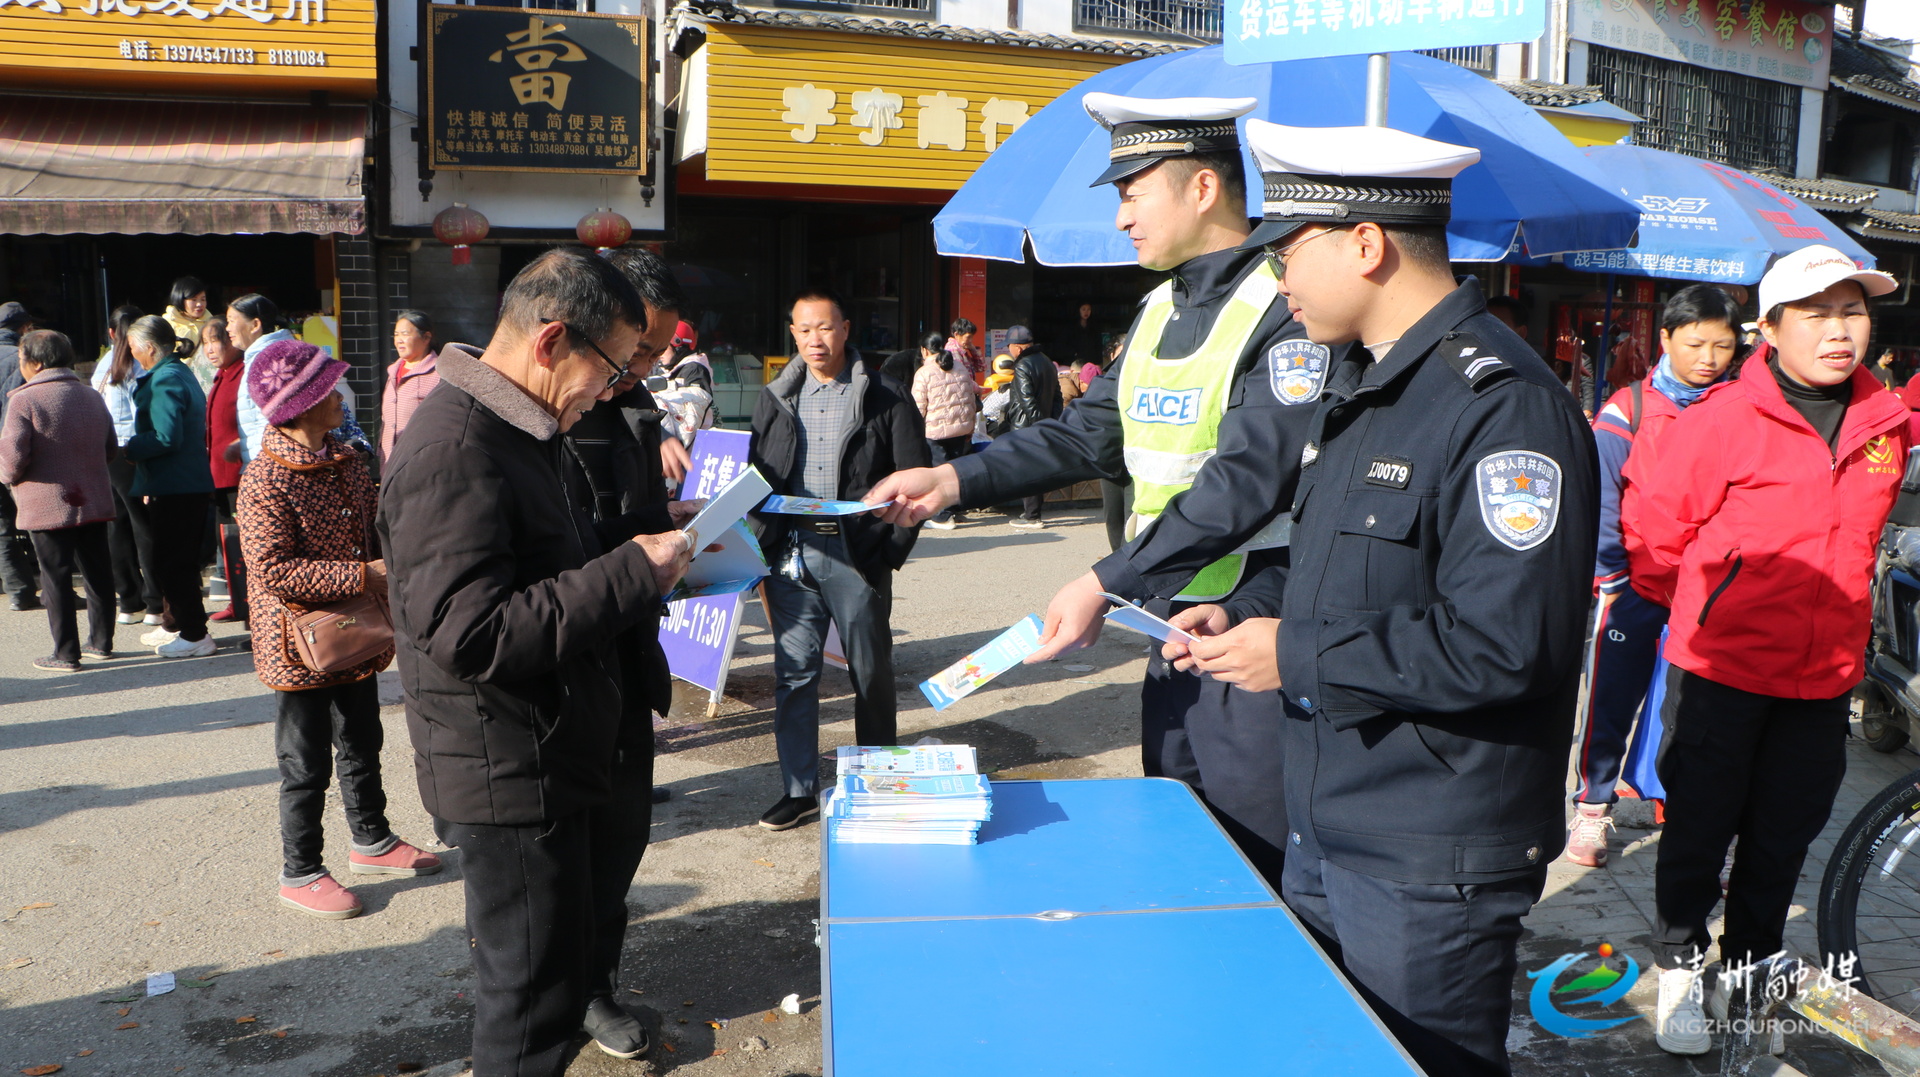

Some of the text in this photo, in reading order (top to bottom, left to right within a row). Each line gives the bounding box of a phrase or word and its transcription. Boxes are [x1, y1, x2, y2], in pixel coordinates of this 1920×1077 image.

[119, 39, 326, 66] 电话: 13974547133 8181084
[446, 109, 627, 133] 快捷诚信 简便灵活
[446, 127, 629, 145] 房产 汽车 摩托车 电动车 黄金 家电 电脑
[296, 221, 312, 232] 155
[315, 221, 335, 232] 2610
[1668, 215, 1717, 225] HORSE
[1574, 251, 1745, 278] 战马能量型维生素饮料
[1484, 456, 1556, 480] 中华人民共和国
[1489, 476, 1551, 496] 警 察
[660, 598, 727, 649] :00-11:30
